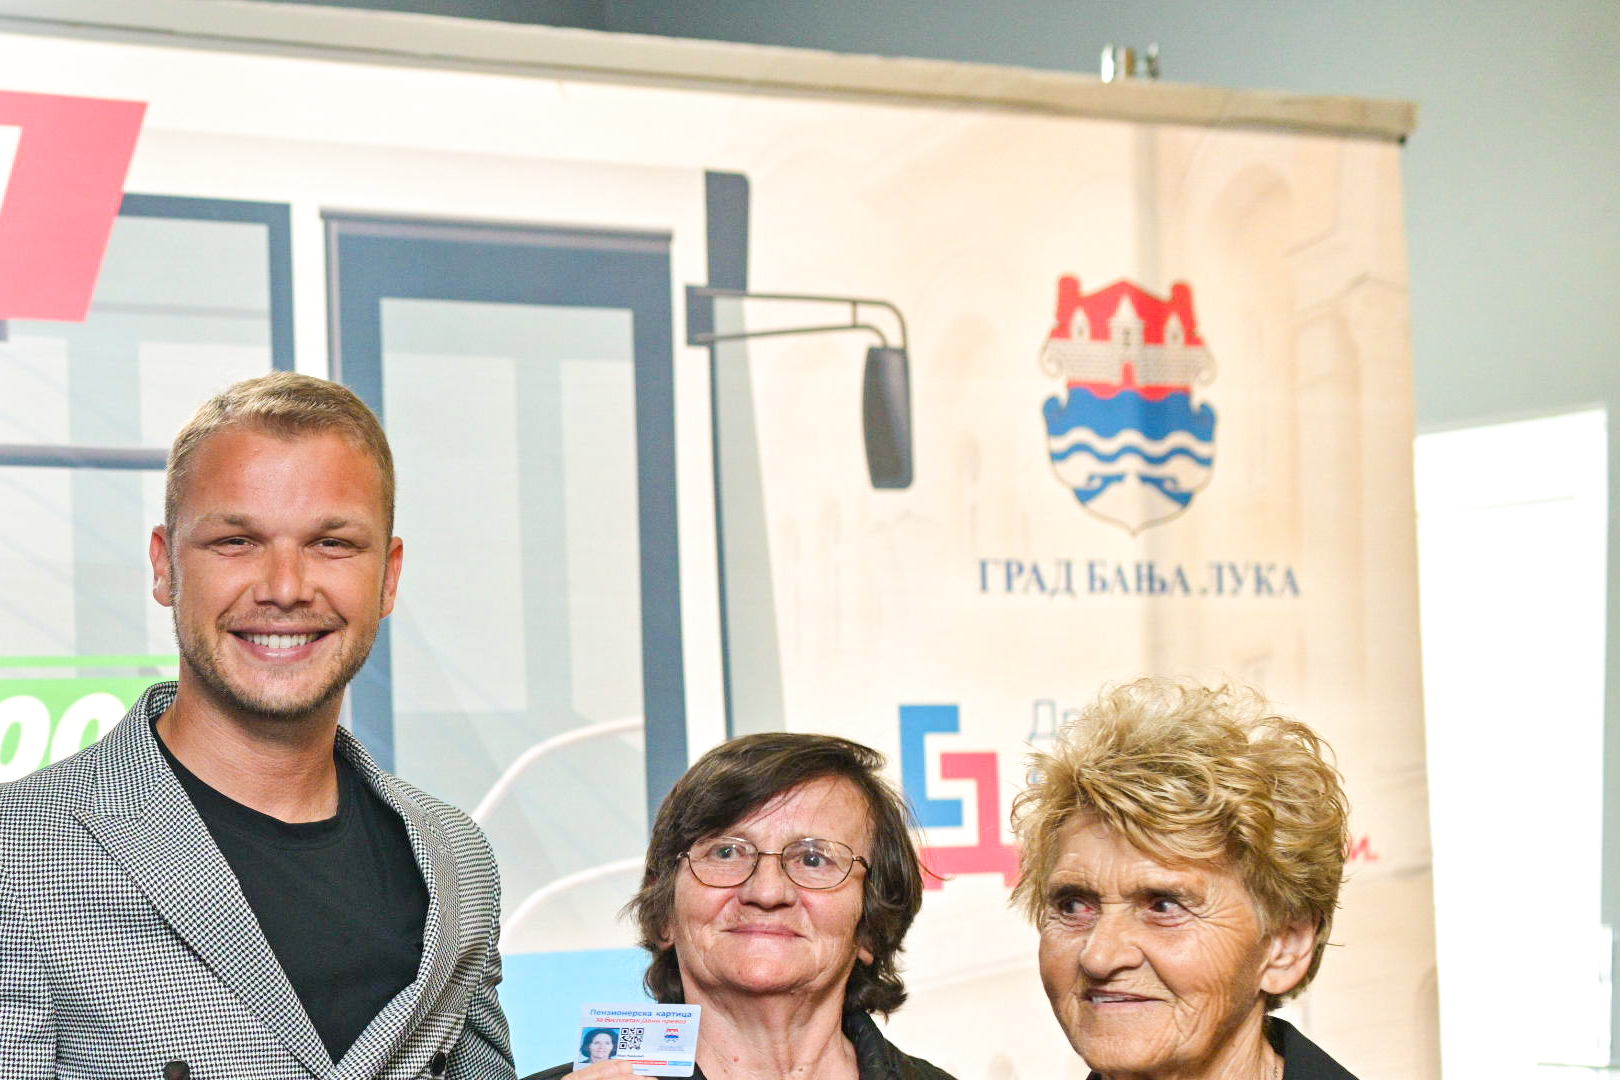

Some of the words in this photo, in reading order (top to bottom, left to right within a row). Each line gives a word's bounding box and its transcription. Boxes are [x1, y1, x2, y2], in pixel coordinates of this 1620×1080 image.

[978, 557, 1077, 599] ГРАД
[1086, 559, 1192, 598] БАЊА
[589, 1008, 652, 1018] Пензионерска
[655, 1010, 692, 1019] картица
